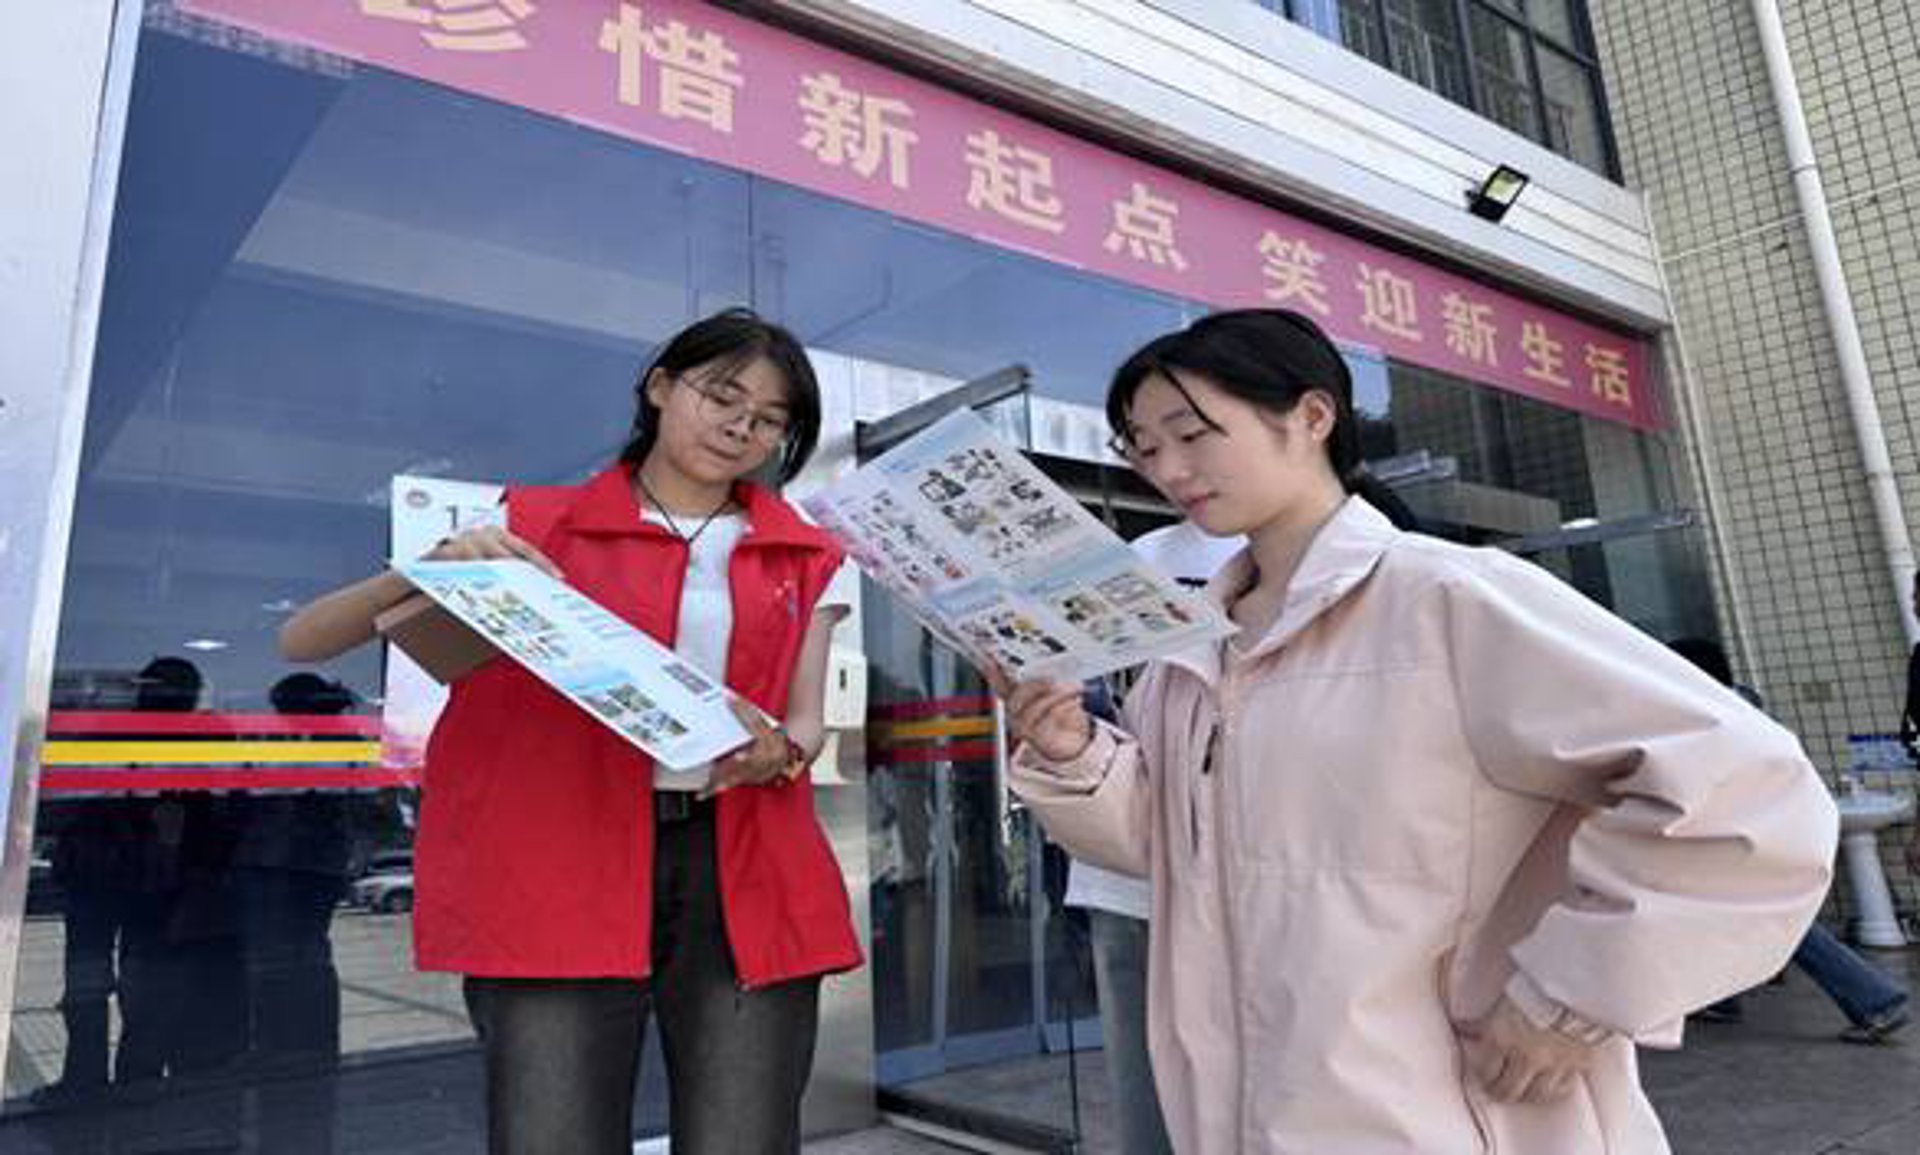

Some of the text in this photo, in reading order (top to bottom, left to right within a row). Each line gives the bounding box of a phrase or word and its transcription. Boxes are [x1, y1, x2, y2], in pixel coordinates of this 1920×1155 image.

[1260, 230, 1632, 406] 笑迎新生活
